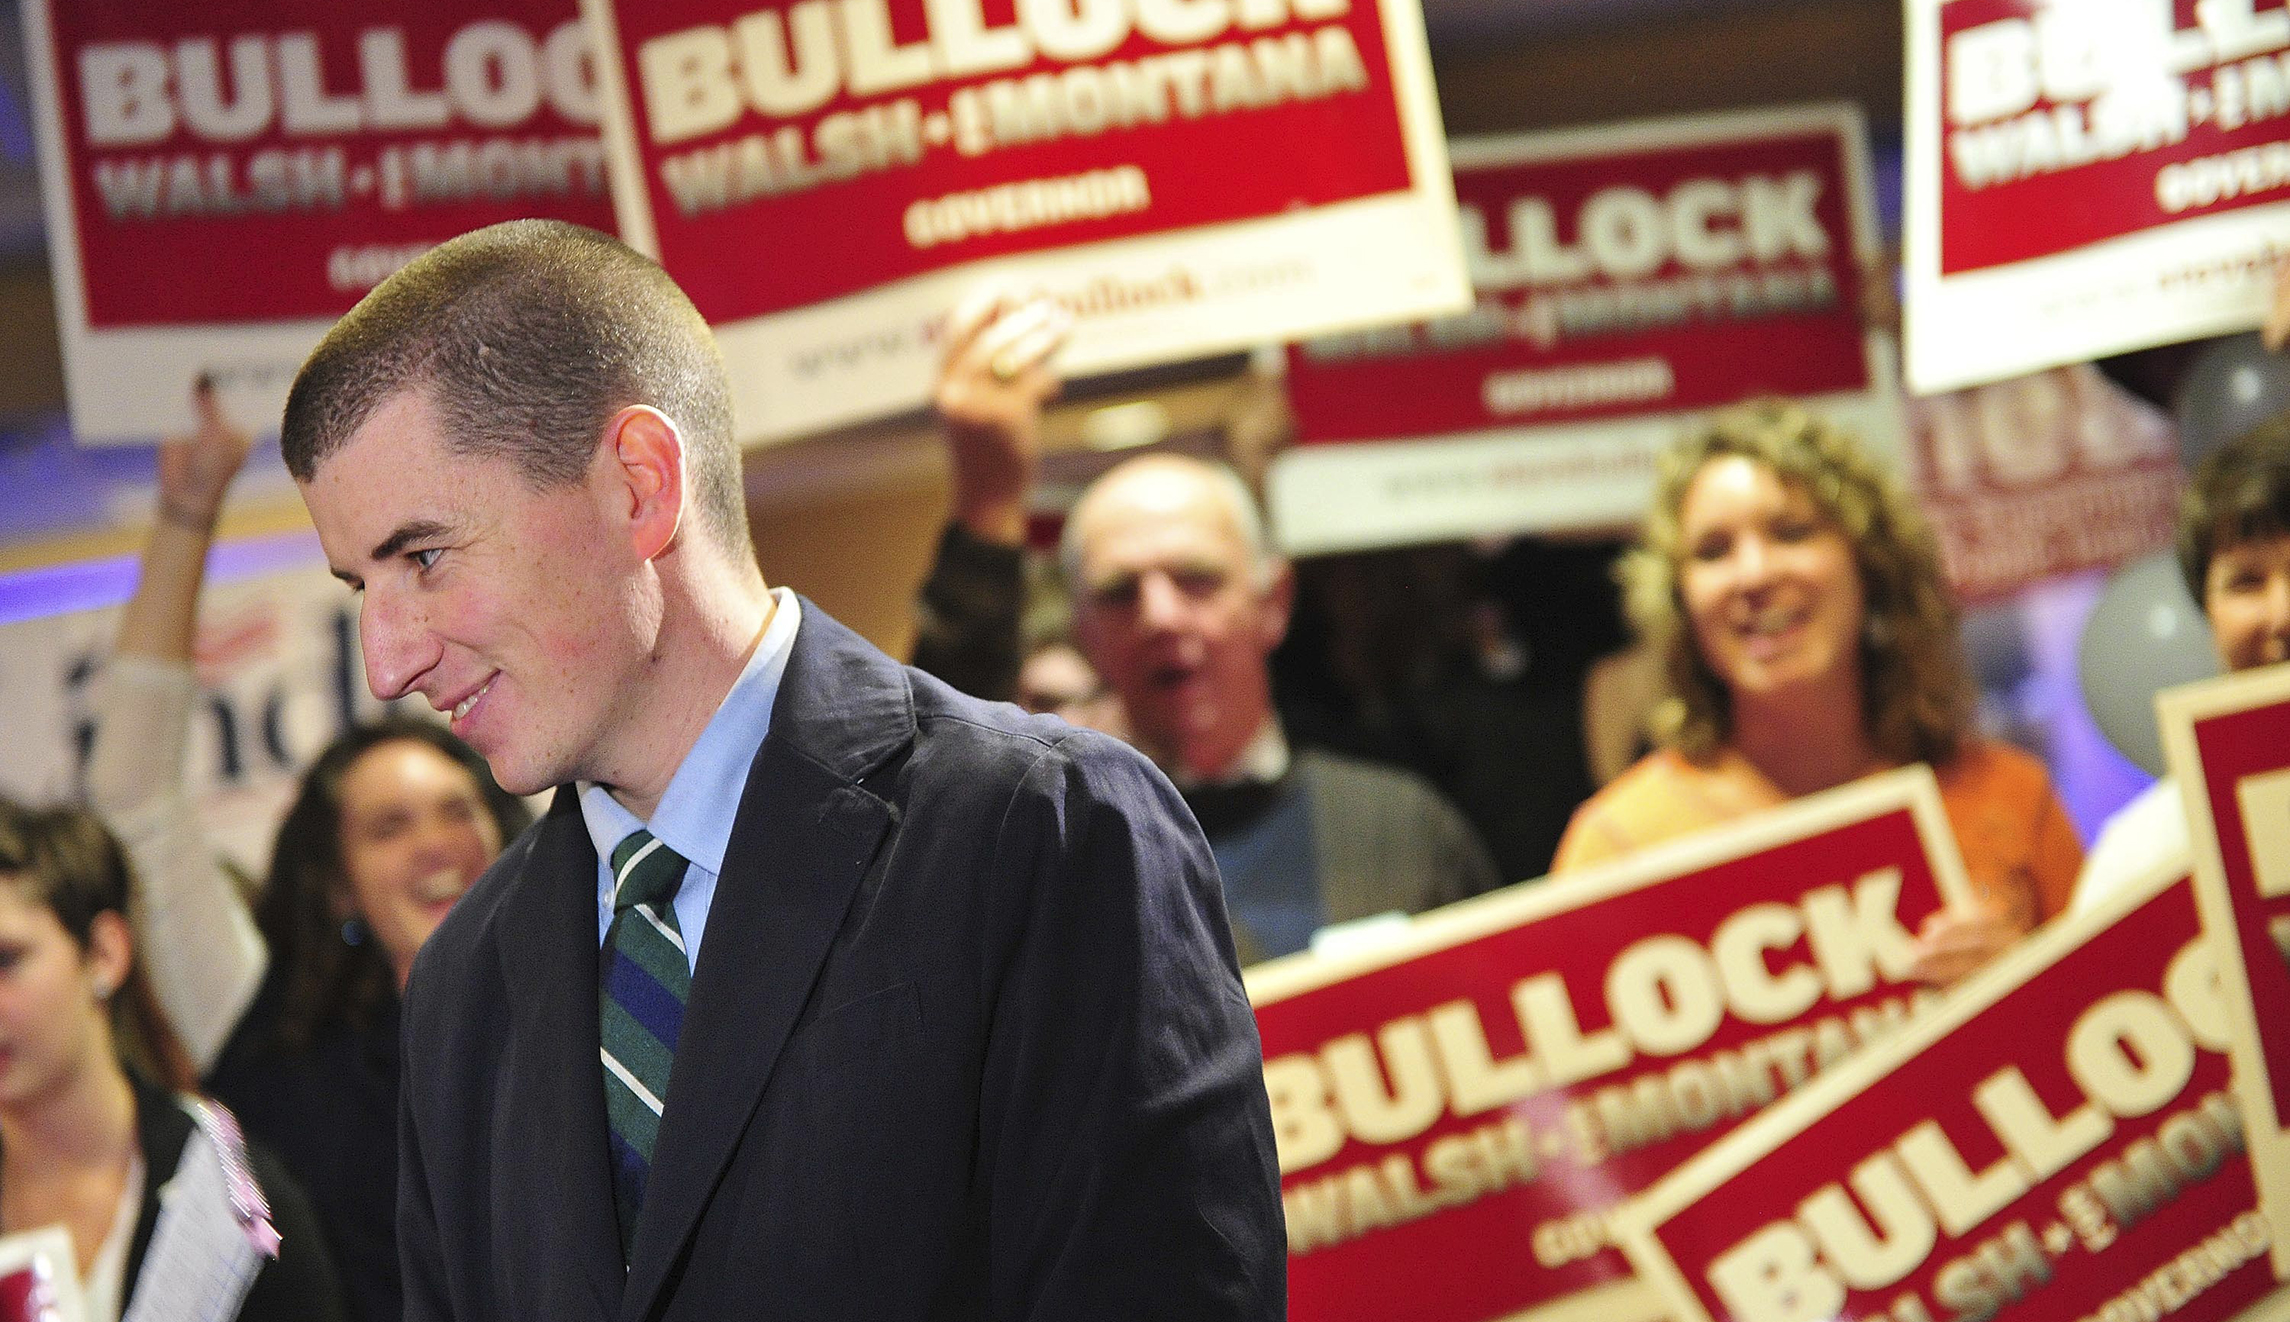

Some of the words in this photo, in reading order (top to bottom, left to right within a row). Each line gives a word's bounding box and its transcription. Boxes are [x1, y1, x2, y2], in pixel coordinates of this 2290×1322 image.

[988, 25, 1372, 147] MONTANA
[903, 165, 1152, 250] GOVERNOR
[1263, 867, 1920, 1174] BULLOCK
